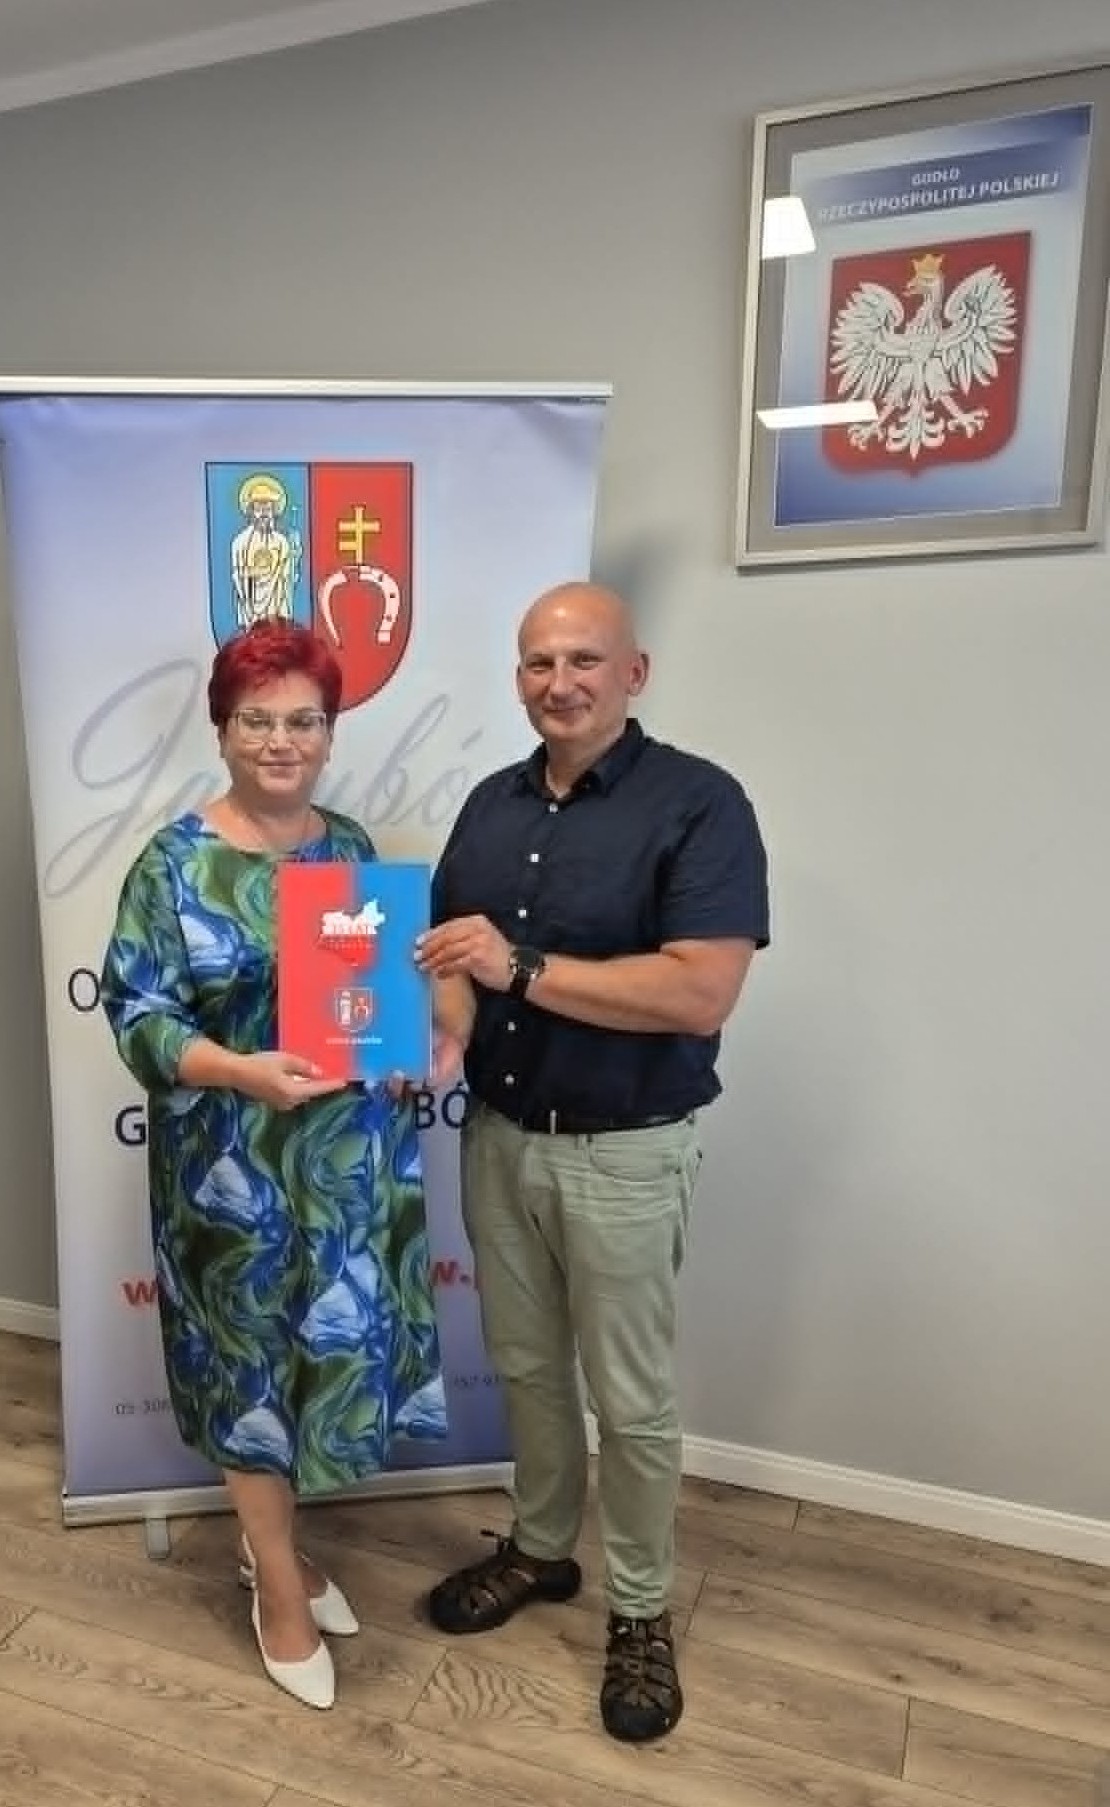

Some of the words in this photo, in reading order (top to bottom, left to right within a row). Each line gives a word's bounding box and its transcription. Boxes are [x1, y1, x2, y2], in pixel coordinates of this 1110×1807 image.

[911, 166, 961, 187] GODŁO
[818, 186, 976, 223] RZECZYPOSPOLITEJ
[979, 171, 1062, 199] POLSKIEJ
